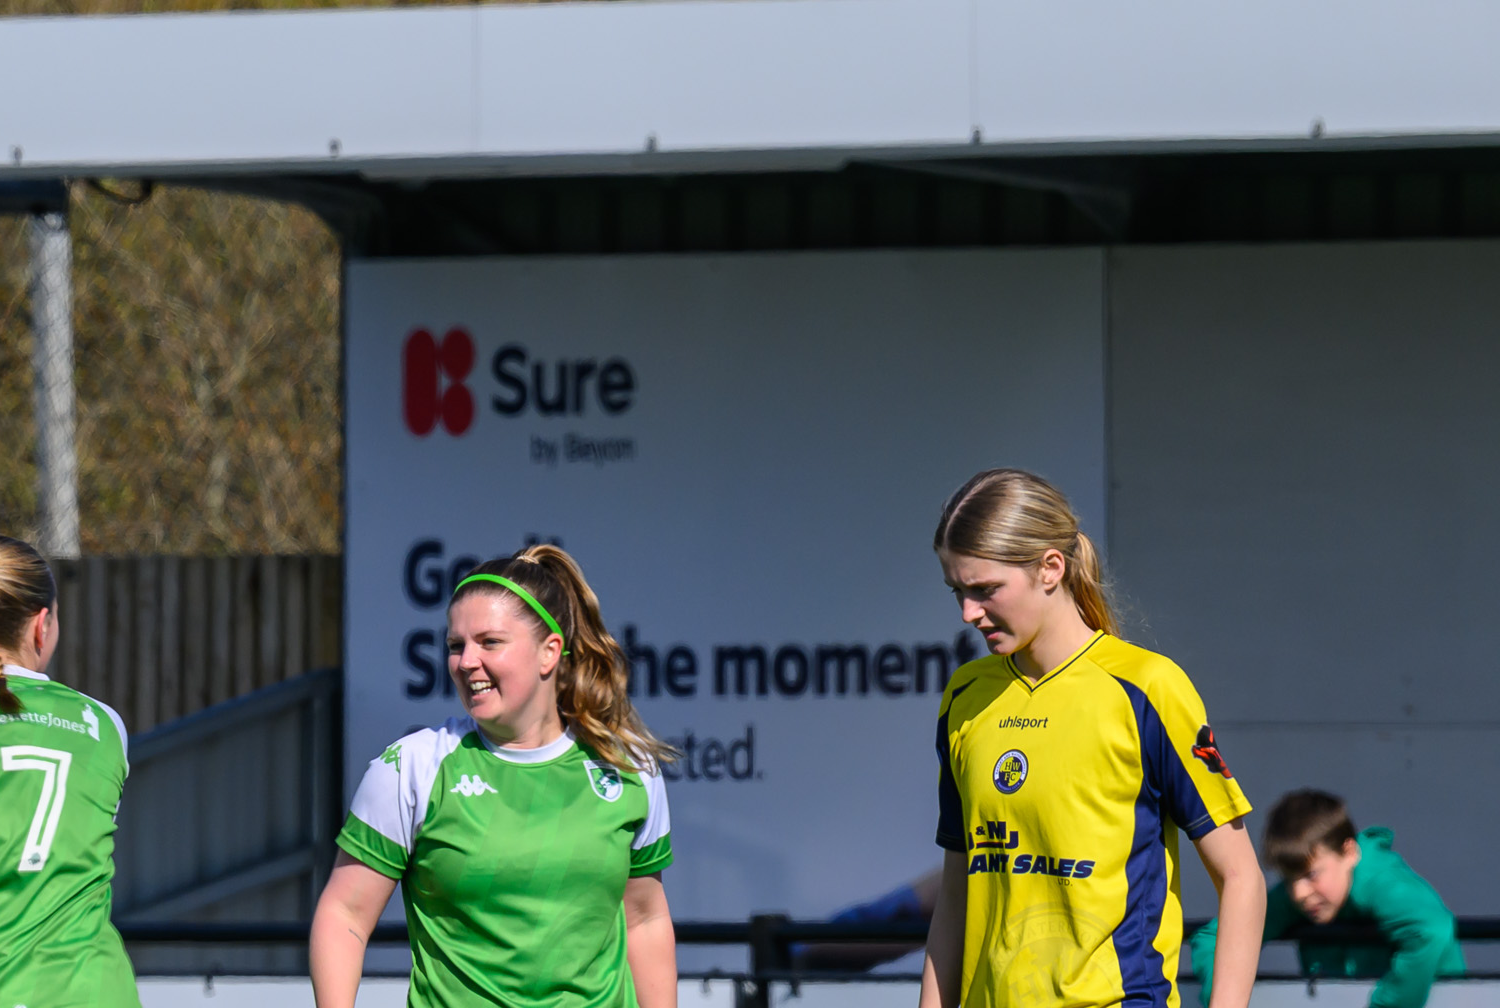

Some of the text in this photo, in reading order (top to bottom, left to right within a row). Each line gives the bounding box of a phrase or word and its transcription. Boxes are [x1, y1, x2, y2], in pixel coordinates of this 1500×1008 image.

[491, 345, 635, 416] Sure
[626, 625, 697, 696] he
[999, 715, 1048, 730] uhlsport
[0, 745, 72, 872] 7
[968, 853, 1096, 879] ANT SALES
